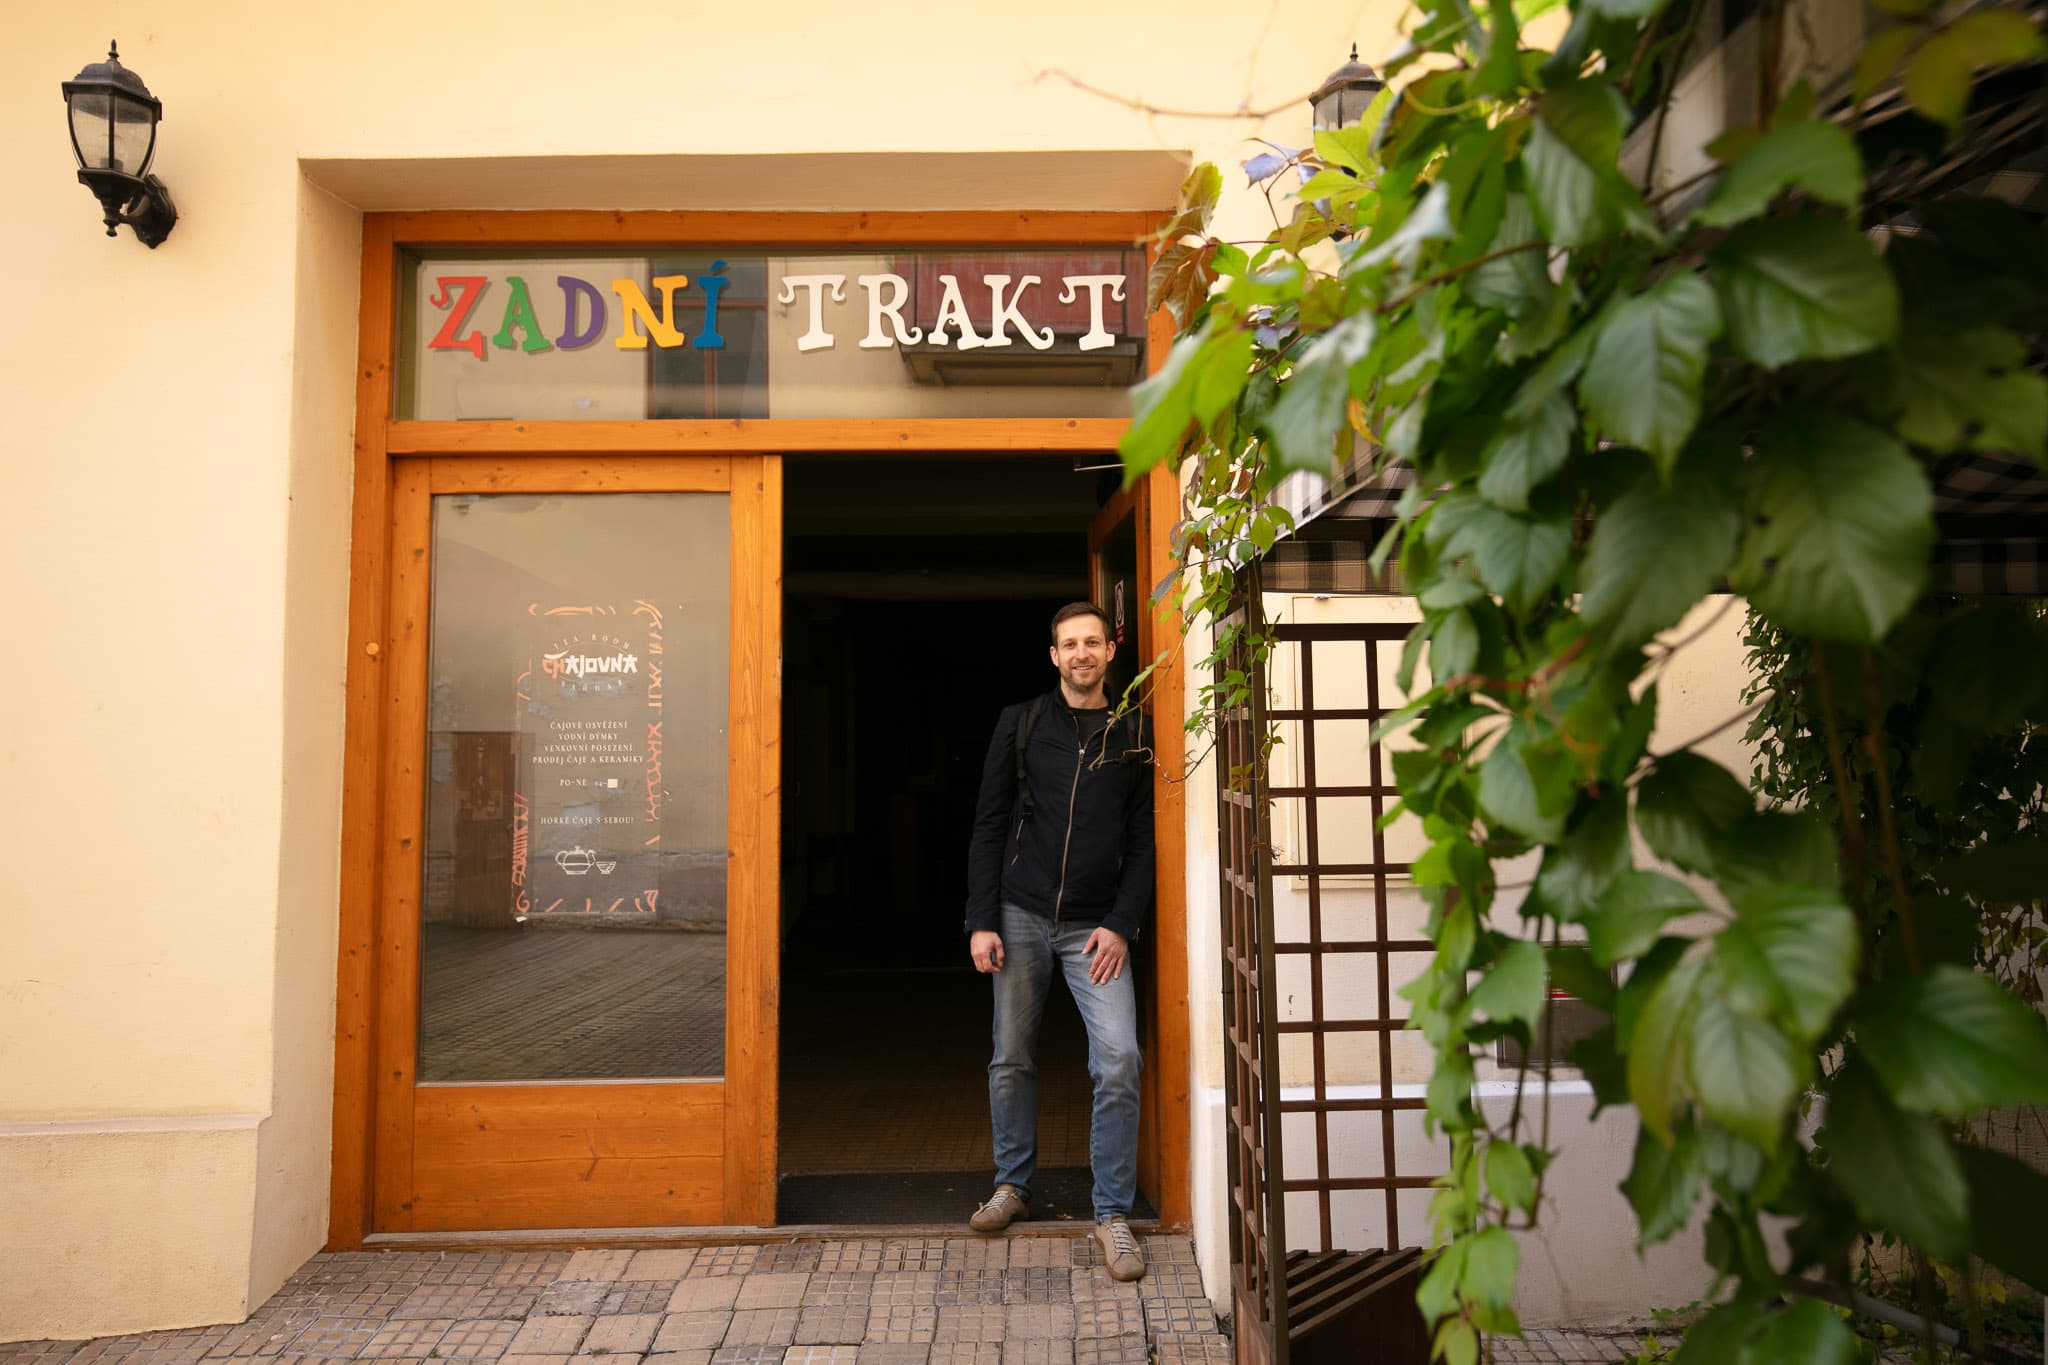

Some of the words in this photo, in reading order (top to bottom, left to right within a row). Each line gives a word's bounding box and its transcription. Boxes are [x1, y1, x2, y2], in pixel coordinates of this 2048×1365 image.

[428, 260, 728, 359] ZADNÍ
[778, 273, 1127, 351] TRAKT
[554, 635, 580, 650] TEA
[591, 633, 630, 649] ROOM
[532, 756, 564, 765] PRODEJ
[599, 755, 643, 763] KERAMIKY
